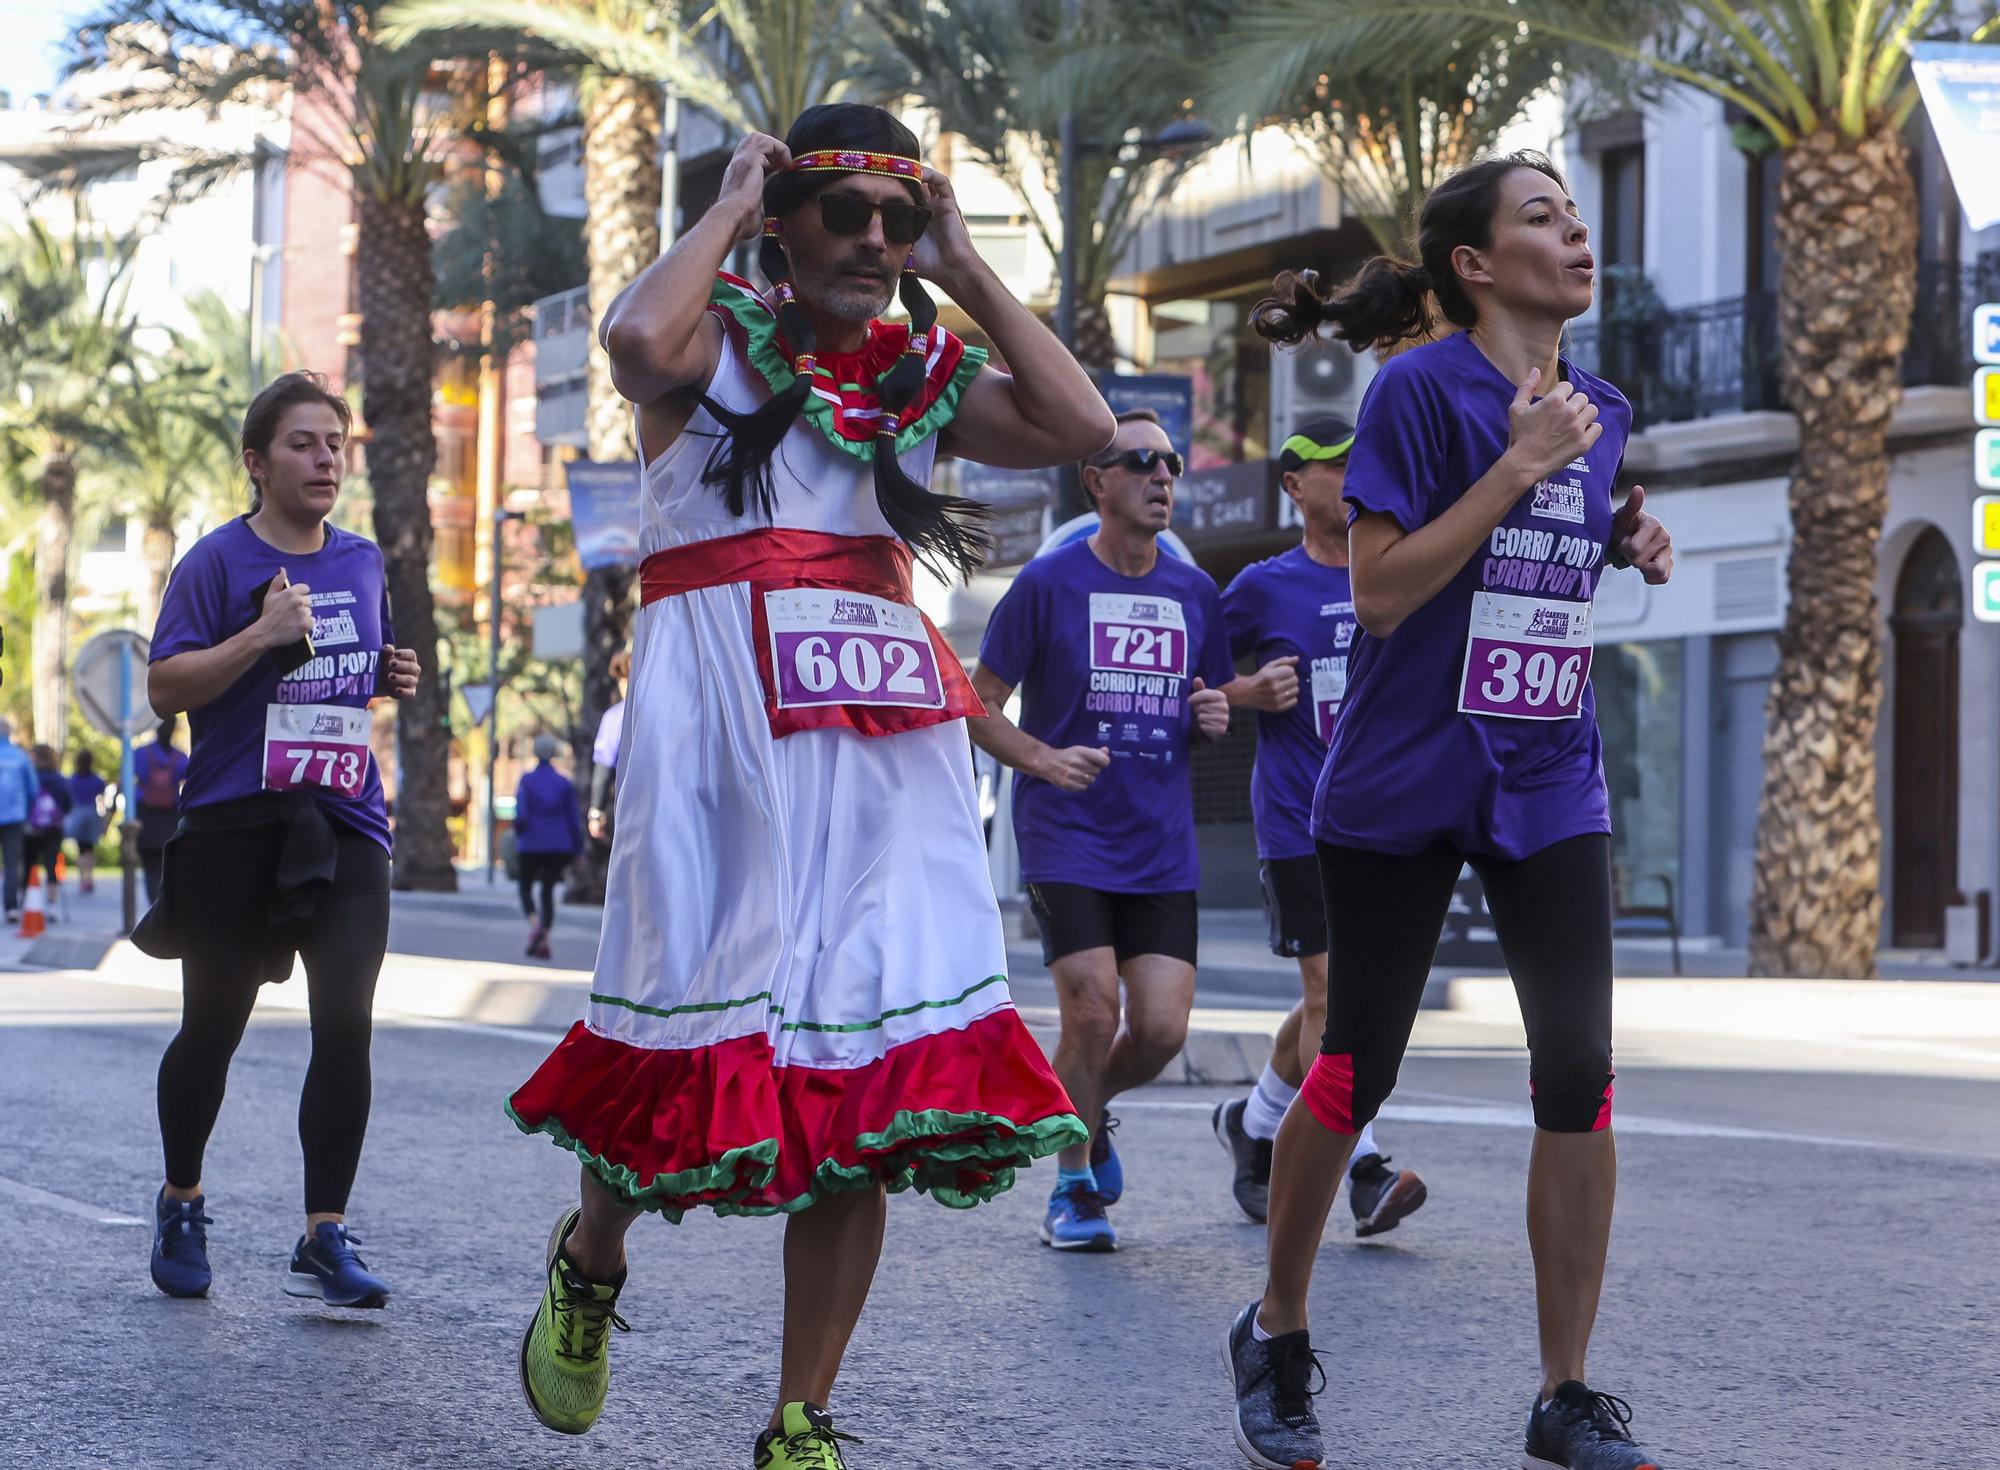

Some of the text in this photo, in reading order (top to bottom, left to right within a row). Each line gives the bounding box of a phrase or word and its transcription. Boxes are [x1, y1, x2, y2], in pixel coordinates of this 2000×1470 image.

[1548, 482, 1584, 498] CARRERA
[1569, 478, 1582, 487] 2022
[1548, 502, 1585, 516] CIUDADES
[1558, 494, 1585, 508] DE LAS
[1490, 526, 1602, 569] CORRO POR TI
[1482, 557, 1543, 591] CORRO
[1540, 563, 1580, 595] POR
[847, 601, 873, 610] CARRERA
[1545, 610, 1570, 619] CARRERA
[1106, 625, 1172, 668] 721
[282, 655, 335, 681] ORRO
[795, 636, 926, 694] 602
[1311, 655, 1347, 673] CORR
[1481, 647, 1581, 707] 396
[277, 679, 331, 704] CORRO
[1090, 671, 1180, 698] CORRO POR TI
[1086, 692, 1180, 718] CORRO POR MI
[286, 749, 360, 788] 773
